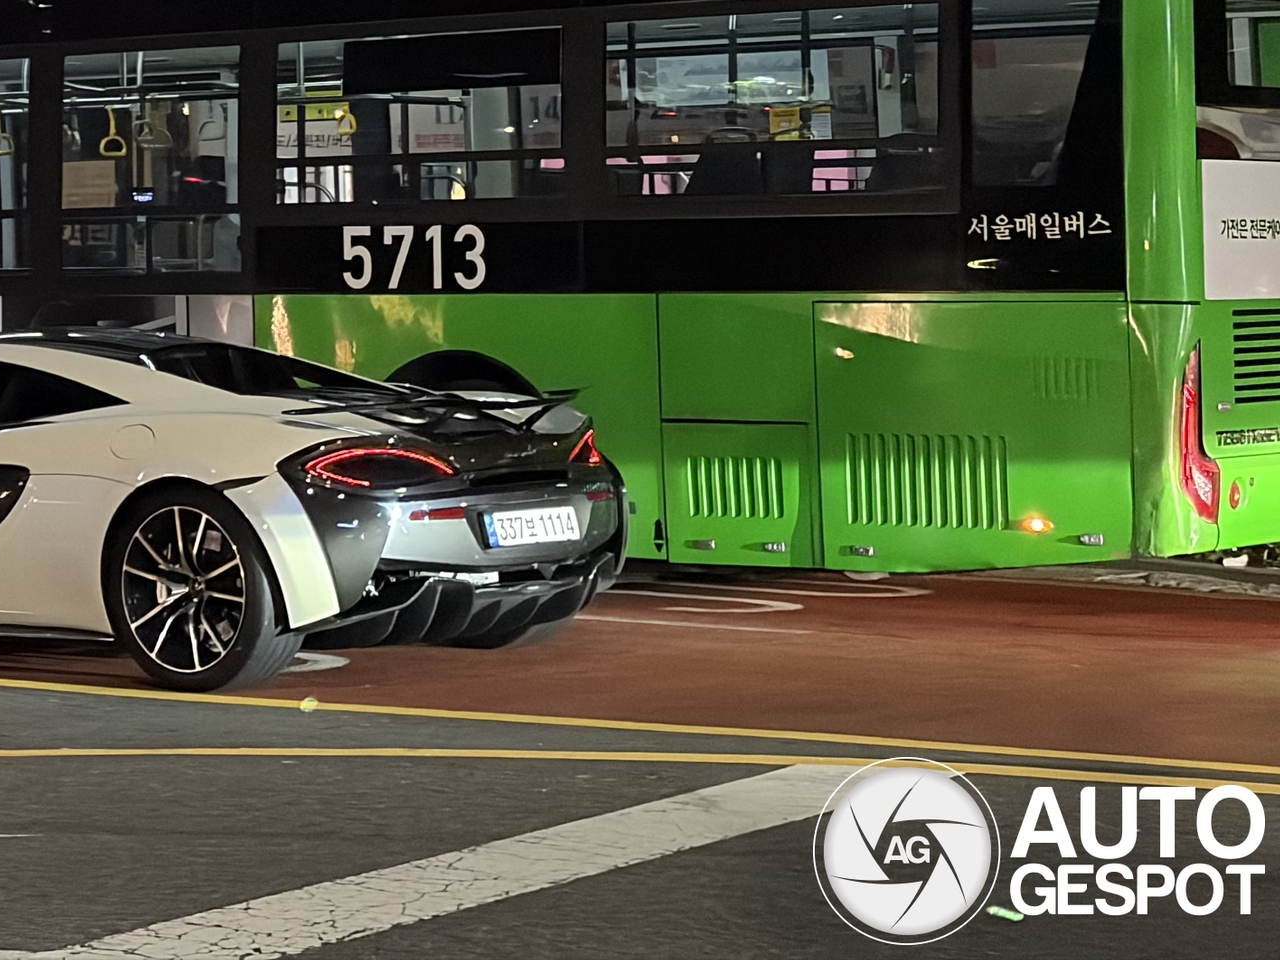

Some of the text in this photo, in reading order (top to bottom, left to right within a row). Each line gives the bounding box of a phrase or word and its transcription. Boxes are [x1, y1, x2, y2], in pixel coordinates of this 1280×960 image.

[967, 211, 1113, 241] 서울매일버스
[1221, 218, 1249, 240] 가전은
[342, 224, 487, 290] 5713
